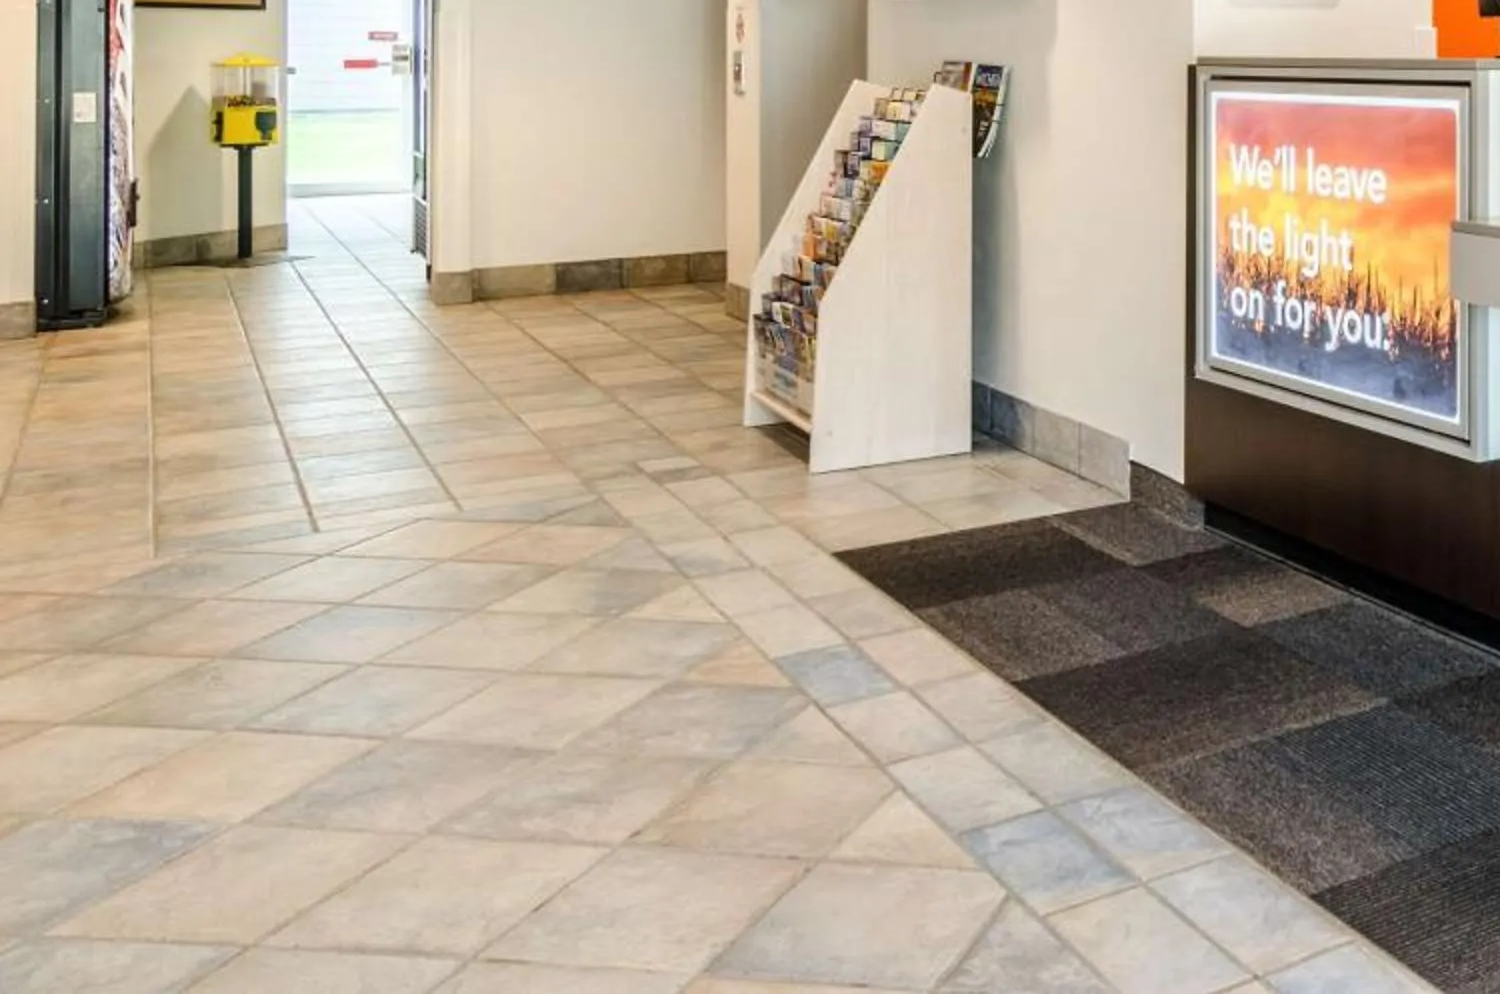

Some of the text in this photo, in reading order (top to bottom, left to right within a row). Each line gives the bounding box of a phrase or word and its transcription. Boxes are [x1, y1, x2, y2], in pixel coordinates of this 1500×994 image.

[1307, 147, 1387, 203] leave
[1229, 207, 1353, 277] the light
[1230, 285, 1264, 321] on
[1273, 279, 1317, 333] for
